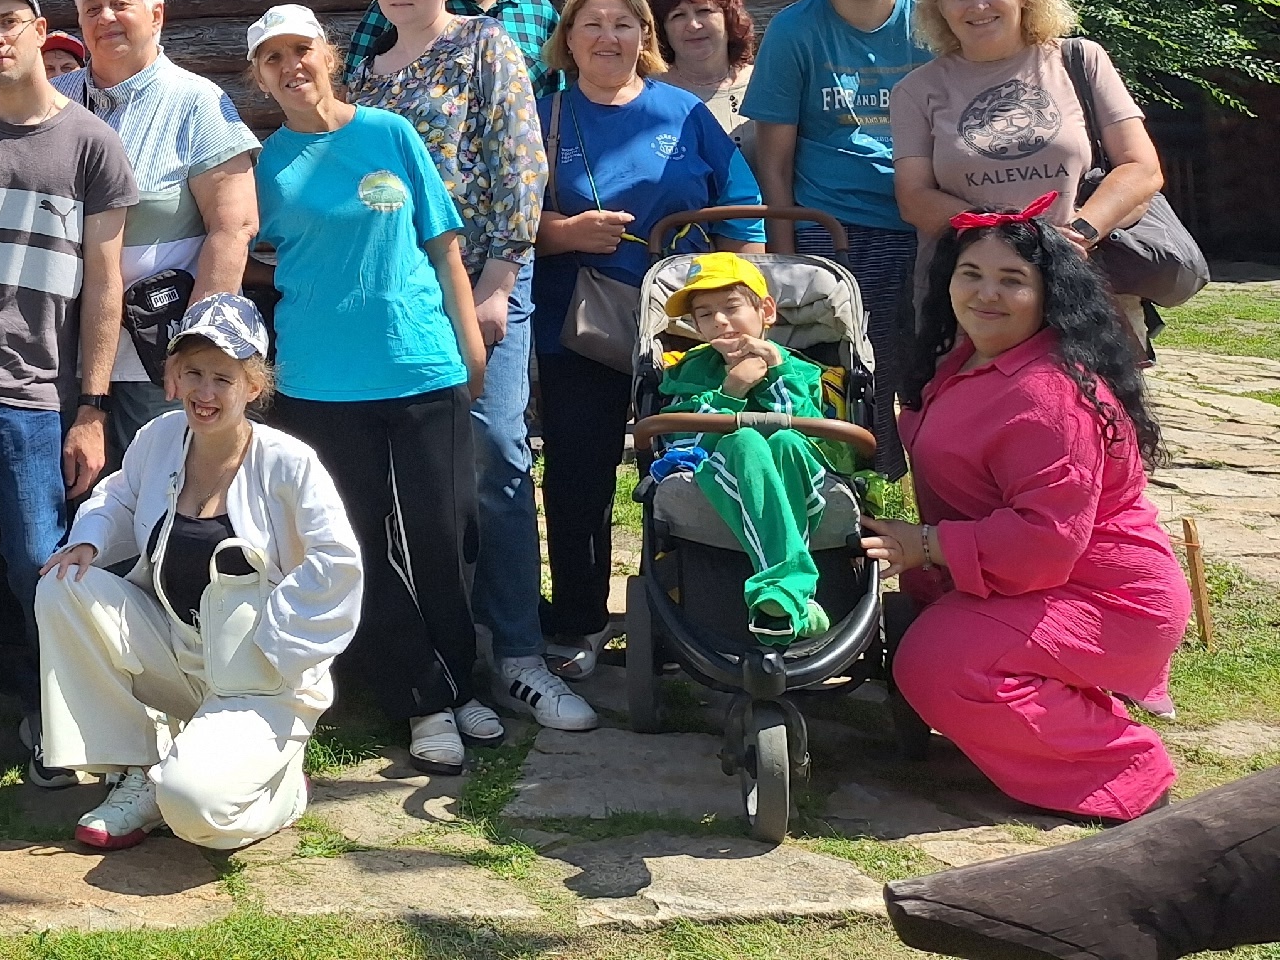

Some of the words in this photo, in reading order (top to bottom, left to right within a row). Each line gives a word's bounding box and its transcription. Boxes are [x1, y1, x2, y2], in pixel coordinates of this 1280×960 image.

[856, 94, 877, 106] AND
[878, 88, 890, 108] B
[965, 163, 1069, 187] KALEVALA
